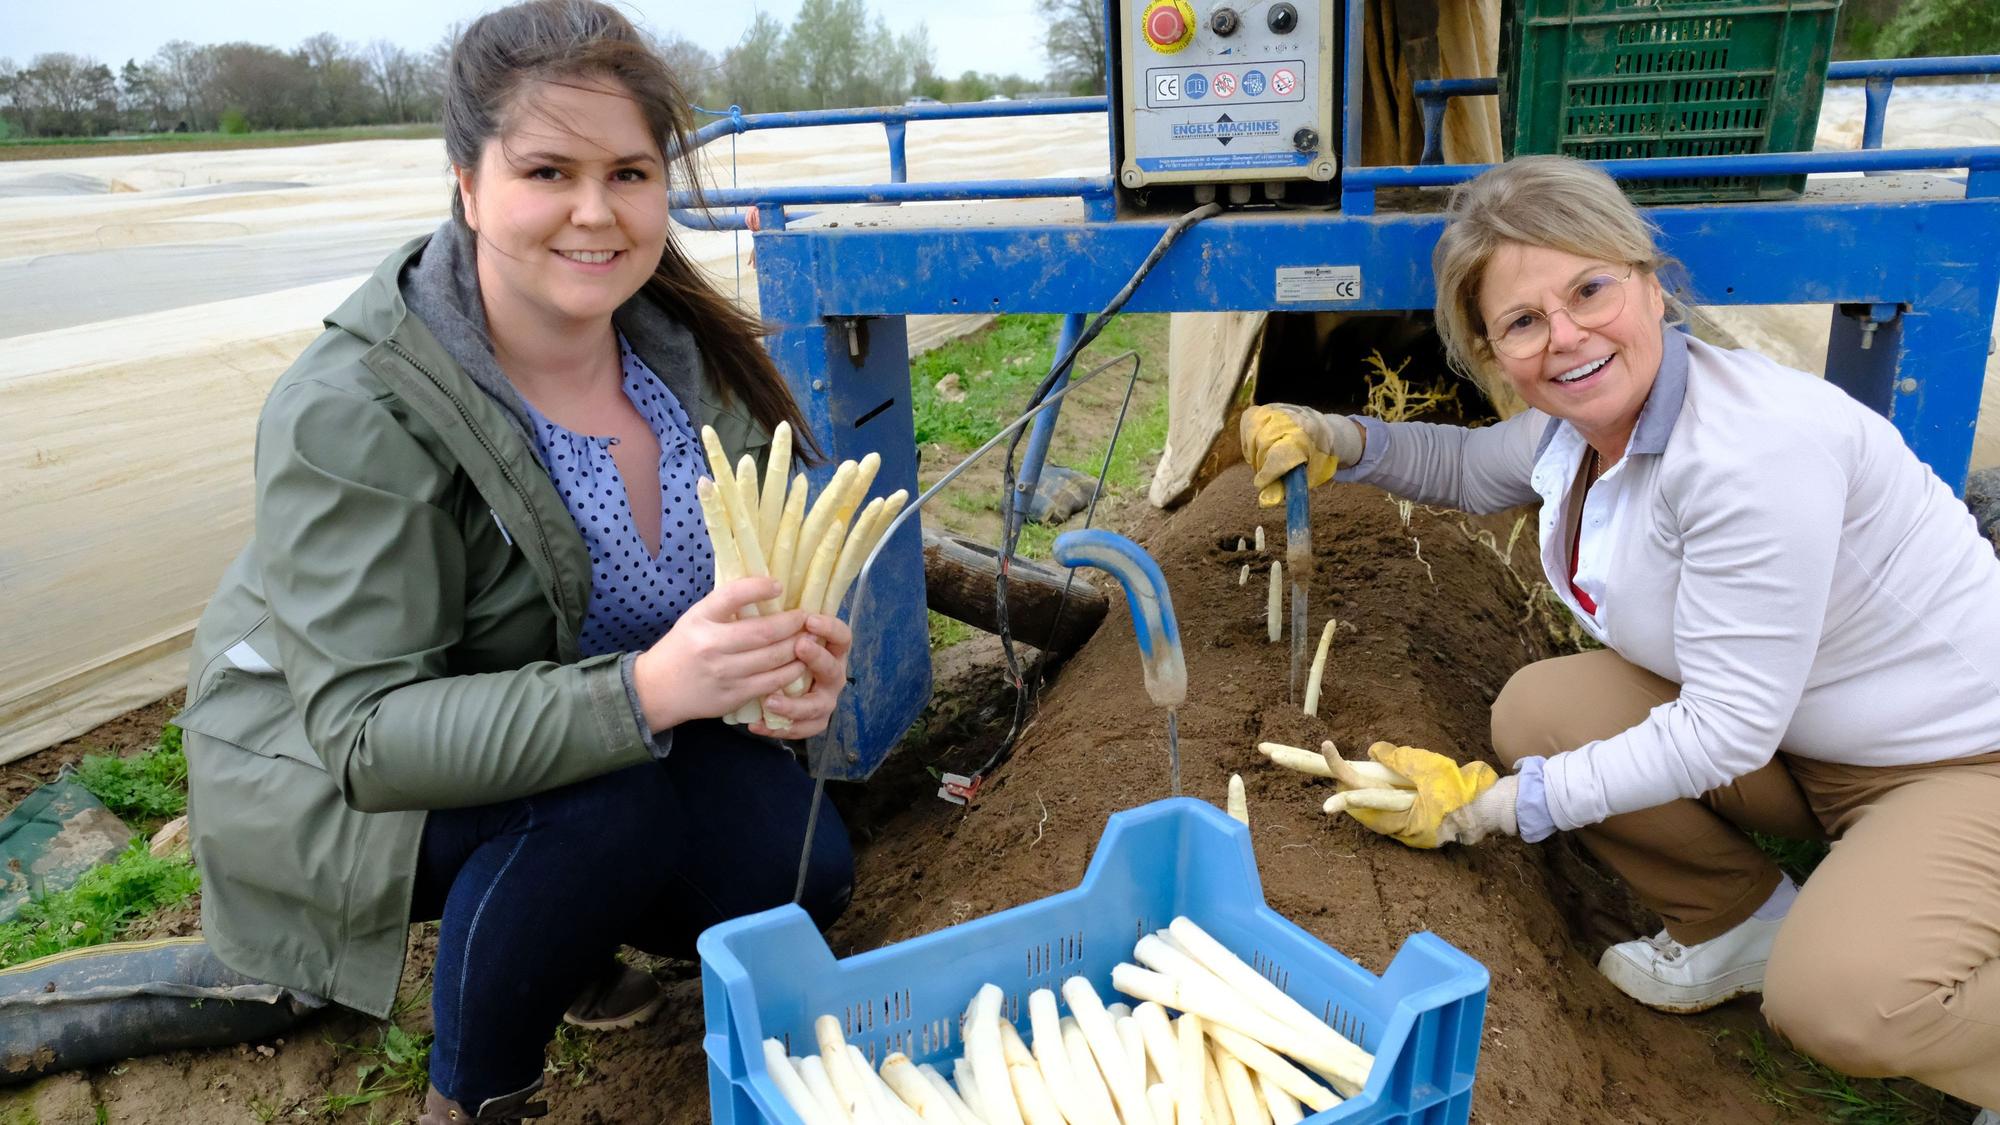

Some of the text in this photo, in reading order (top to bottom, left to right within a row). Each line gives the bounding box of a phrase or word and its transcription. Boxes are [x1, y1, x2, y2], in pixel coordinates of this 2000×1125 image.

[1158, 79, 1177, 96] CE
[1173, 124, 1214, 135] ENGELS
[1218, 121, 1278, 133] MACHINES
[1336, 281, 1354, 297] CE
